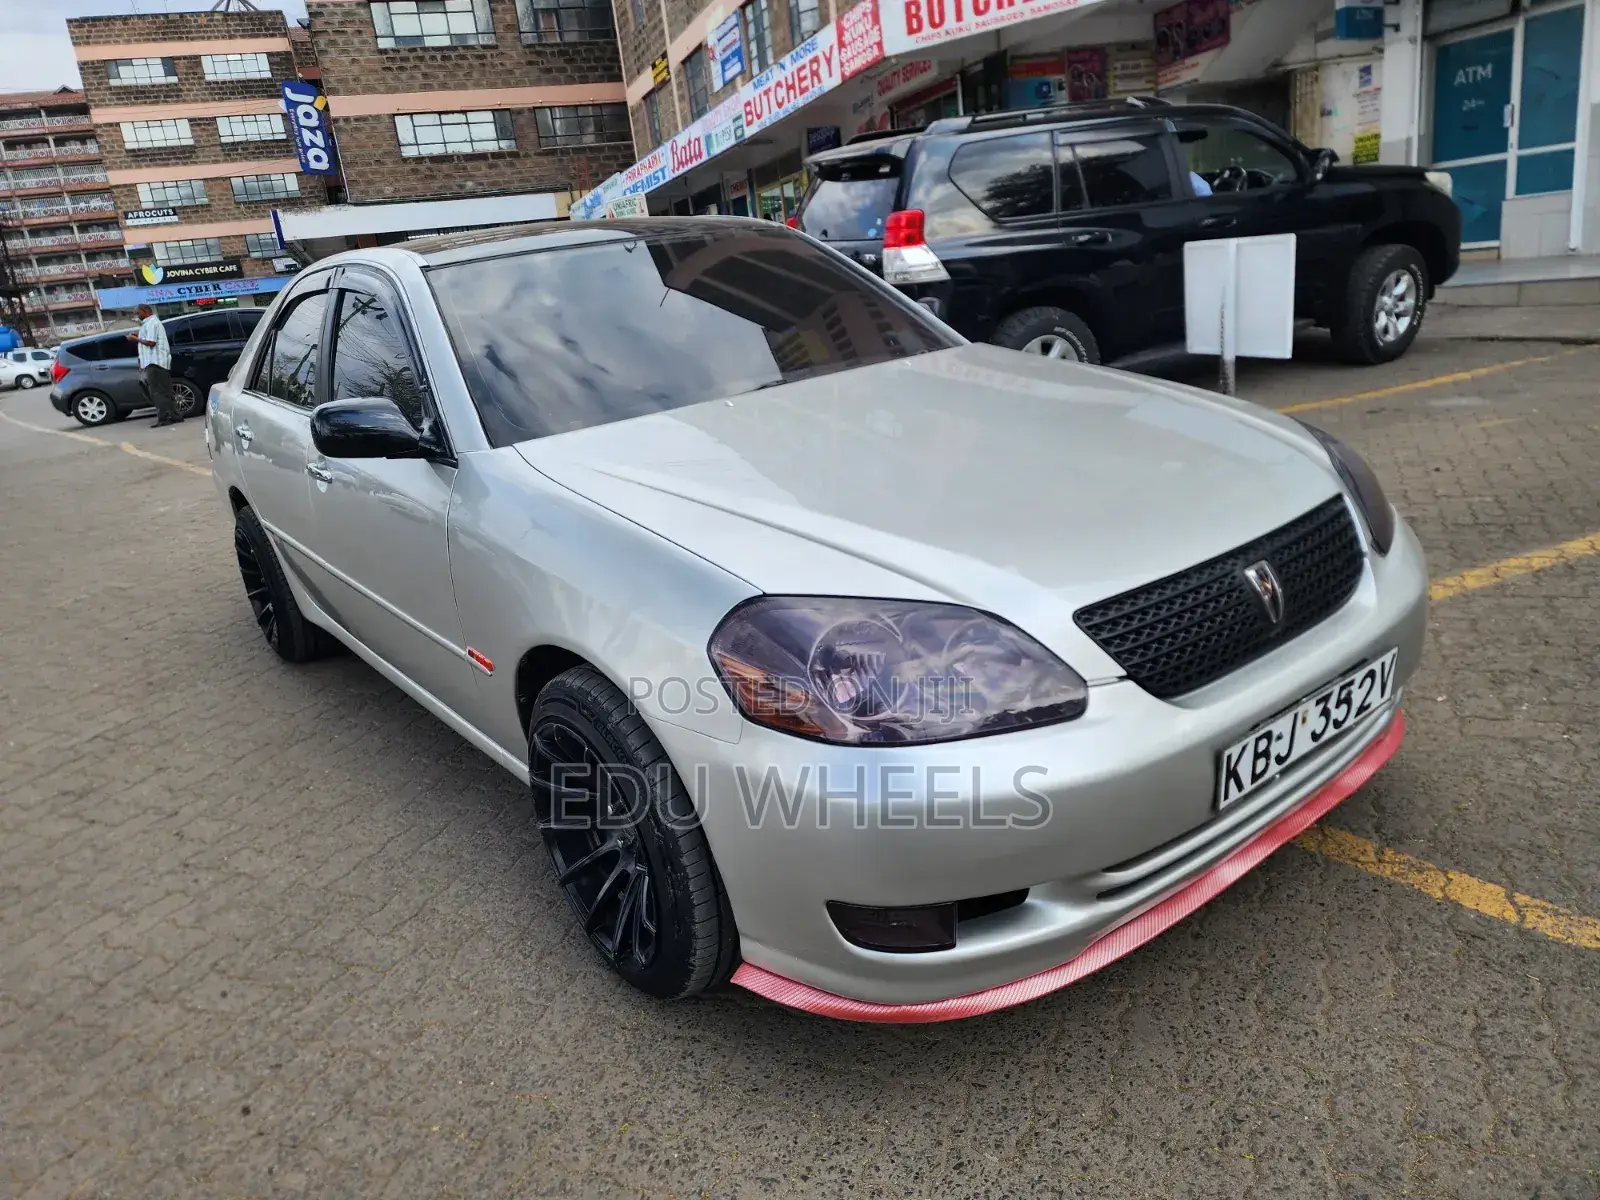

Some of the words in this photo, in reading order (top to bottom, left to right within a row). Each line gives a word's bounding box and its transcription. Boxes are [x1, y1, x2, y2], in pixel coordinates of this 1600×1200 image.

[843, 13, 872, 44] KUKU
[945, 23, 971, 36] KUKU
[752, 69, 774, 92] MEAT
[790, 37, 818, 66] MORE
[1454, 63, 1492, 86] ATM
[743, 44, 834, 127] BUTCHERY
[670, 132, 704, 174] Bata
[128, 209, 173, 219] AFROCUTS
[166, 269, 193, 278] JOVINA
[195, 267, 218, 275] CYBER
[219, 265, 237, 273] CAFE
[177, 283, 221, 295] CYBER
[1223, 712, 1299, 802] KBJ
[1310, 653, 1396, 743] 352V
